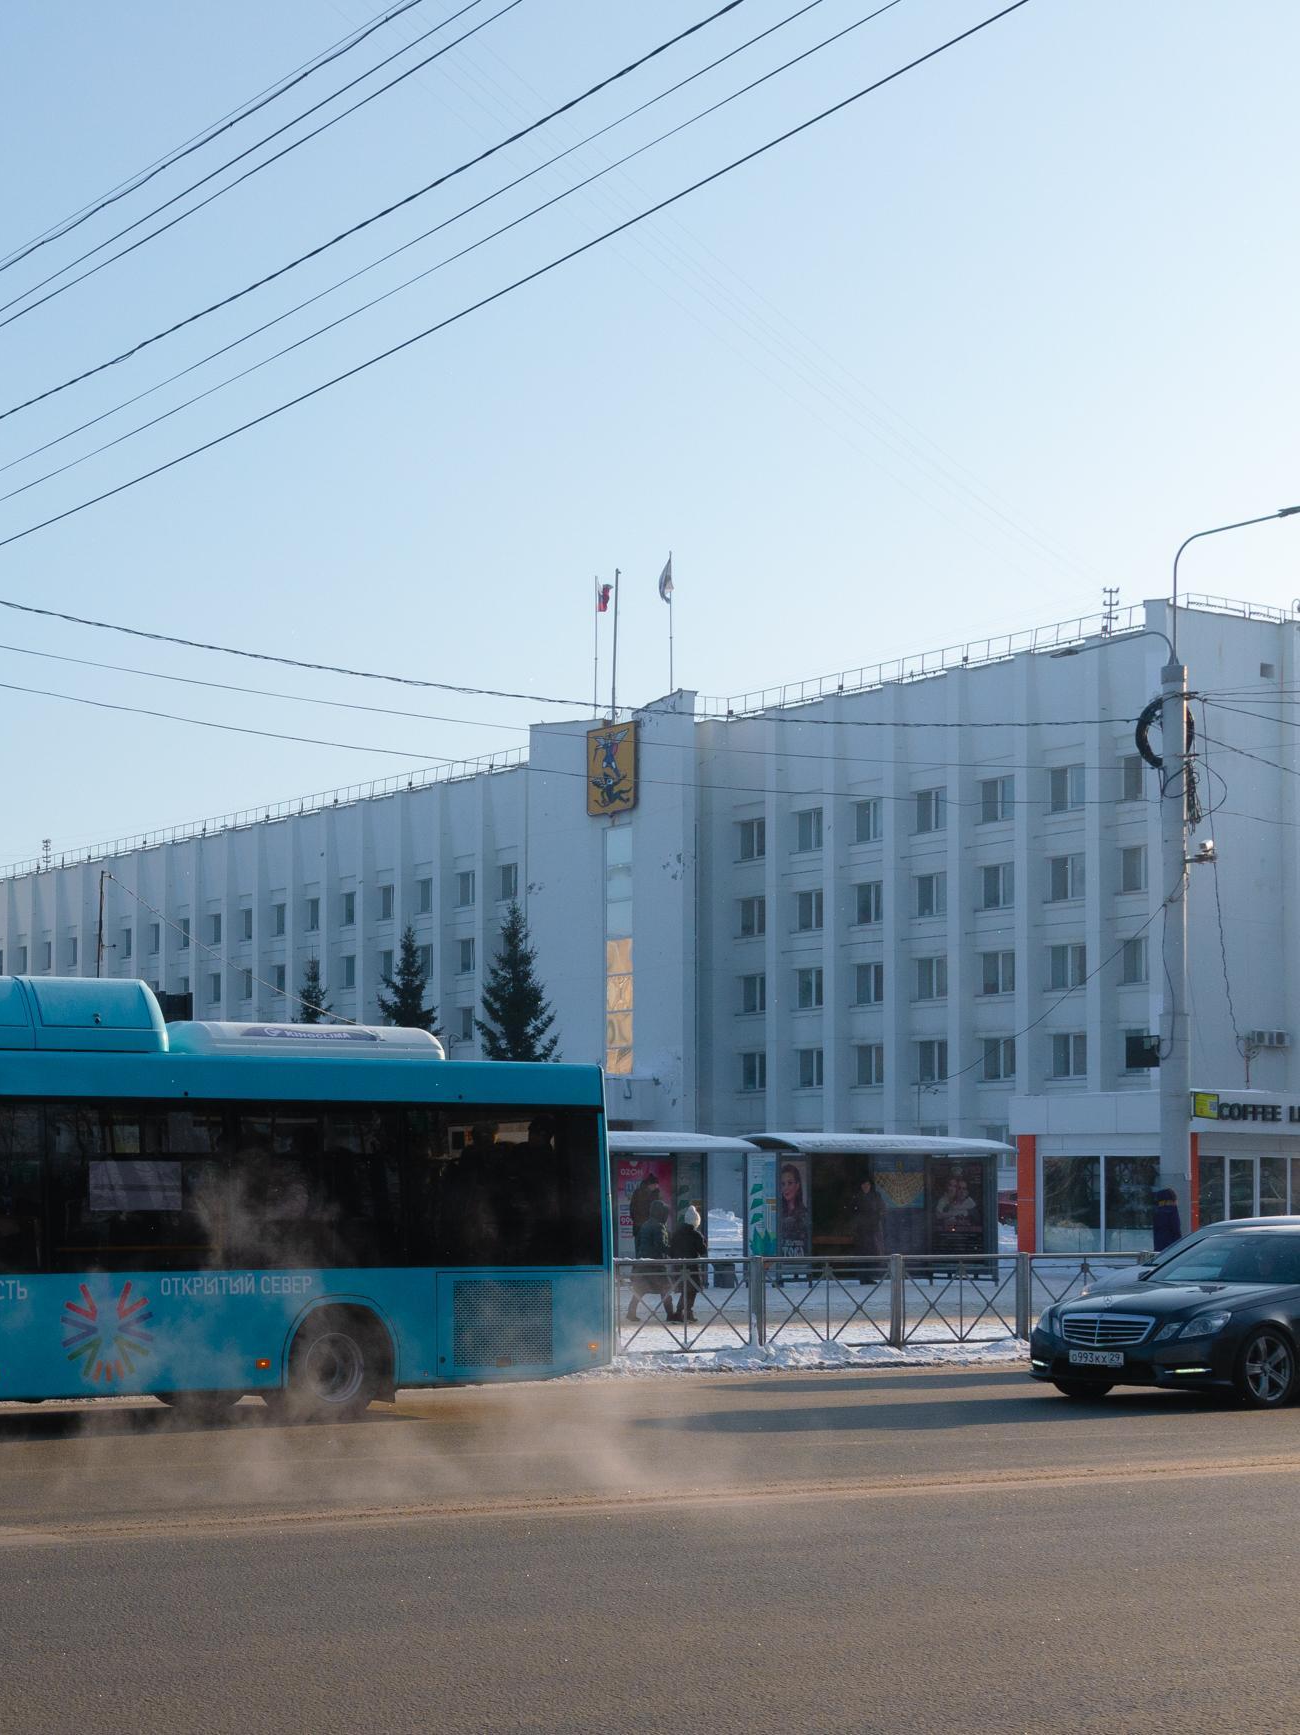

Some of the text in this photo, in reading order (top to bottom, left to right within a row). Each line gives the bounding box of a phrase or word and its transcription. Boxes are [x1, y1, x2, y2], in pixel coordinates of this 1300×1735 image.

[1219, 1102, 1282, 1121] COFFEE
[160, 1273, 313, 1296] ОТКРЫТЫЙ СЕВЕР
